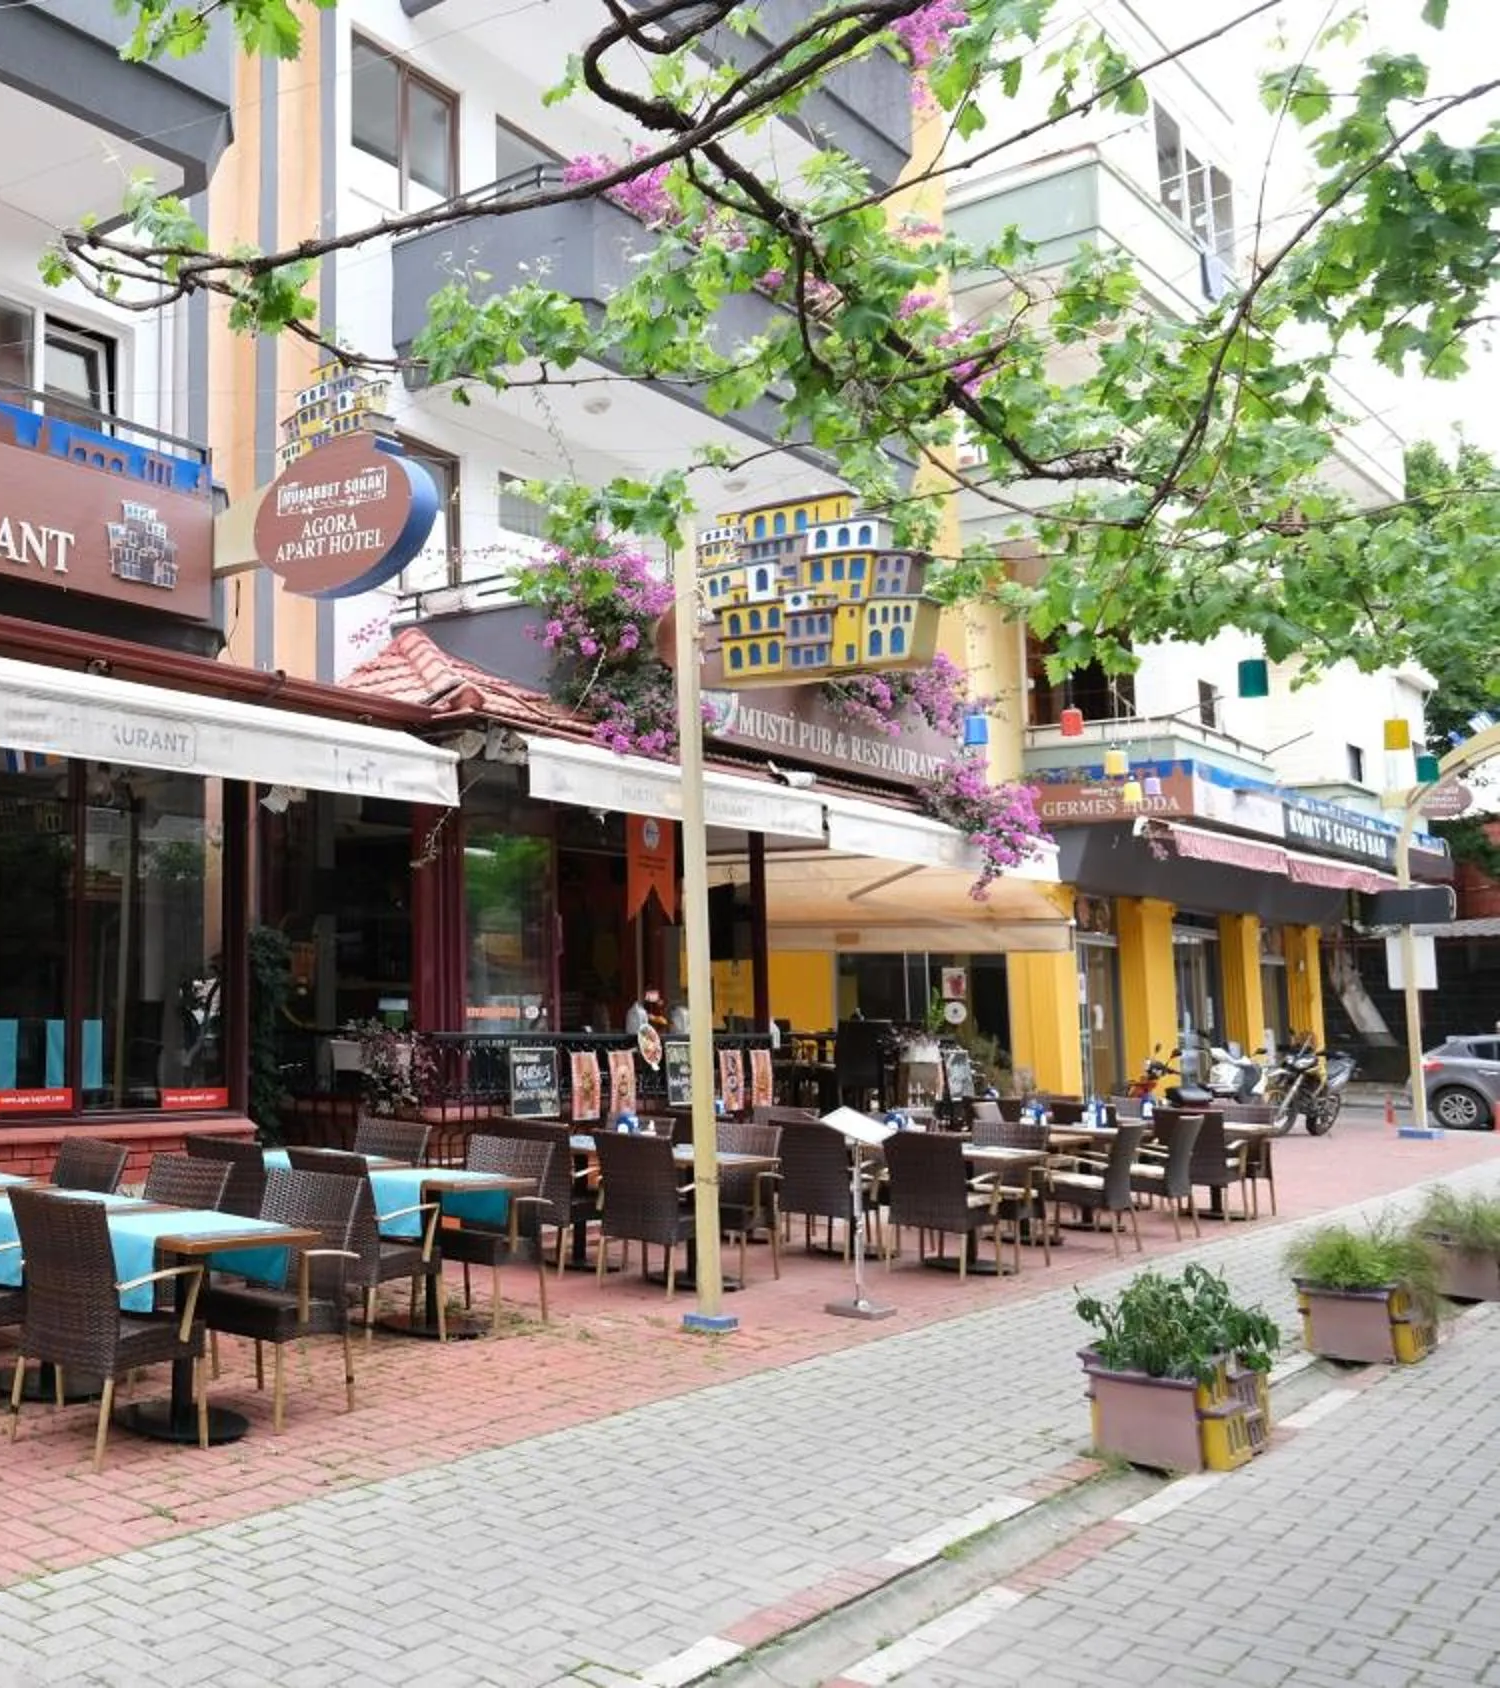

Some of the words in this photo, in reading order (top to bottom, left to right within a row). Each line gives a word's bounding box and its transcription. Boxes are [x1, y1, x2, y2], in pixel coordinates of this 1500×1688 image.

[344, 472, 383, 494] SOKAK
[301, 512, 357, 538] AGORA
[275, 537, 326, 563] APART
[329, 528, 385, 555] HOTEL
[799, 721, 832, 755] PUB
[835, 732, 848, 760] &
[850, 736, 946, 781] RESTAURANT
[1042, 798, 1117, 817] GERMES
